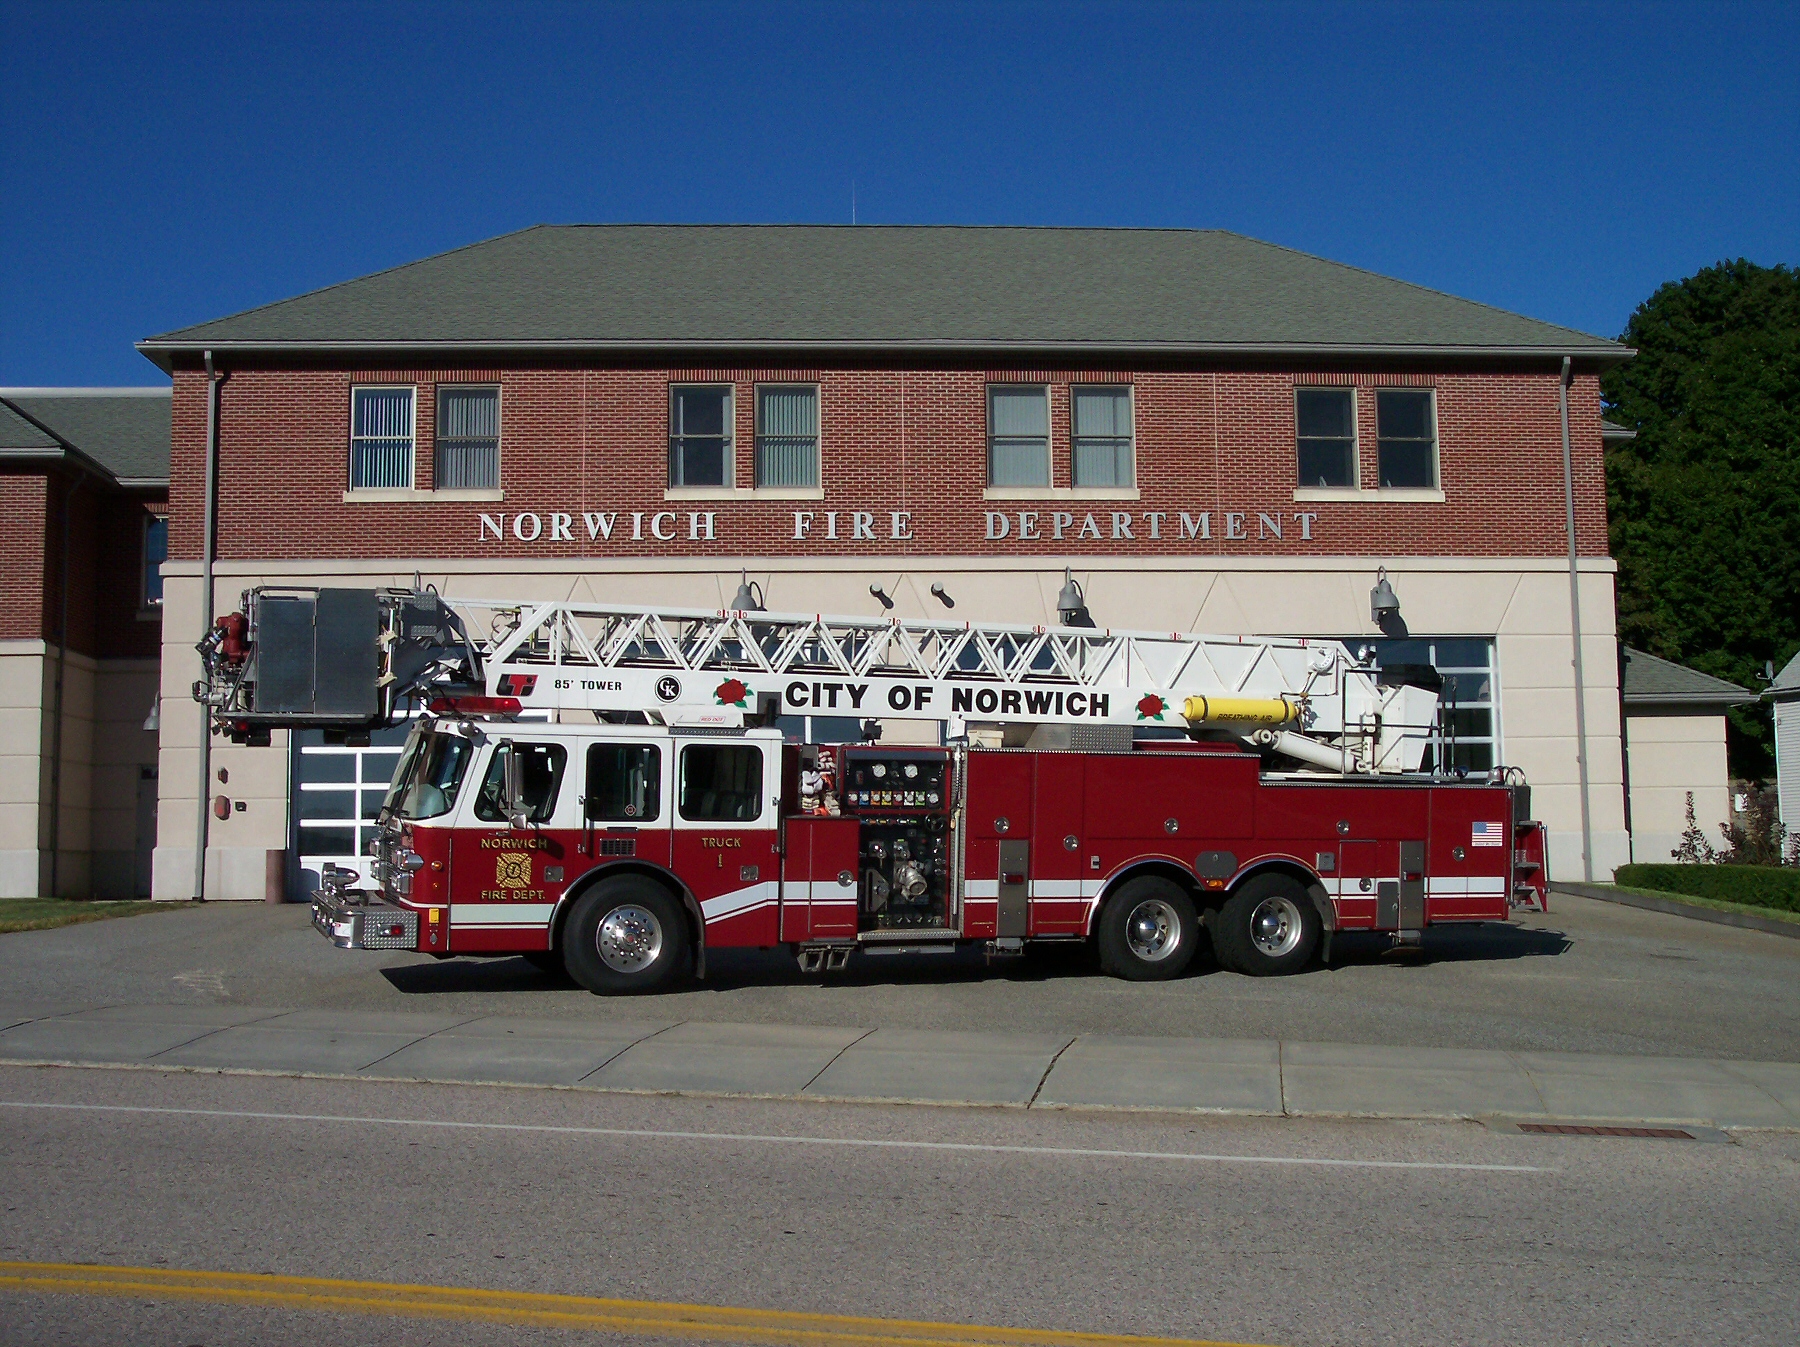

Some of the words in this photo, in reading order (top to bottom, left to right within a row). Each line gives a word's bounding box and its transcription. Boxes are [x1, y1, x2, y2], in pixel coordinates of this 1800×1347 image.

[477, 512, 717, 541] NORWICH
[791, 511, 914, 540] FIRE
[983, 511, 1318, 540] DEPARTMENT
[580, 680, 622, 691] TOWER
[785, 681, 869, 709] CITY
[887, 685, 934, 711] OF
[951, 687, 1109, 717] NORWICH
[481, 838, 548, 849] NORWICH
[701, 837, 741, 848] TRUCK
[481, 890, 507, 900] FIRE
[512, 890, 545, 900] DEPT.
